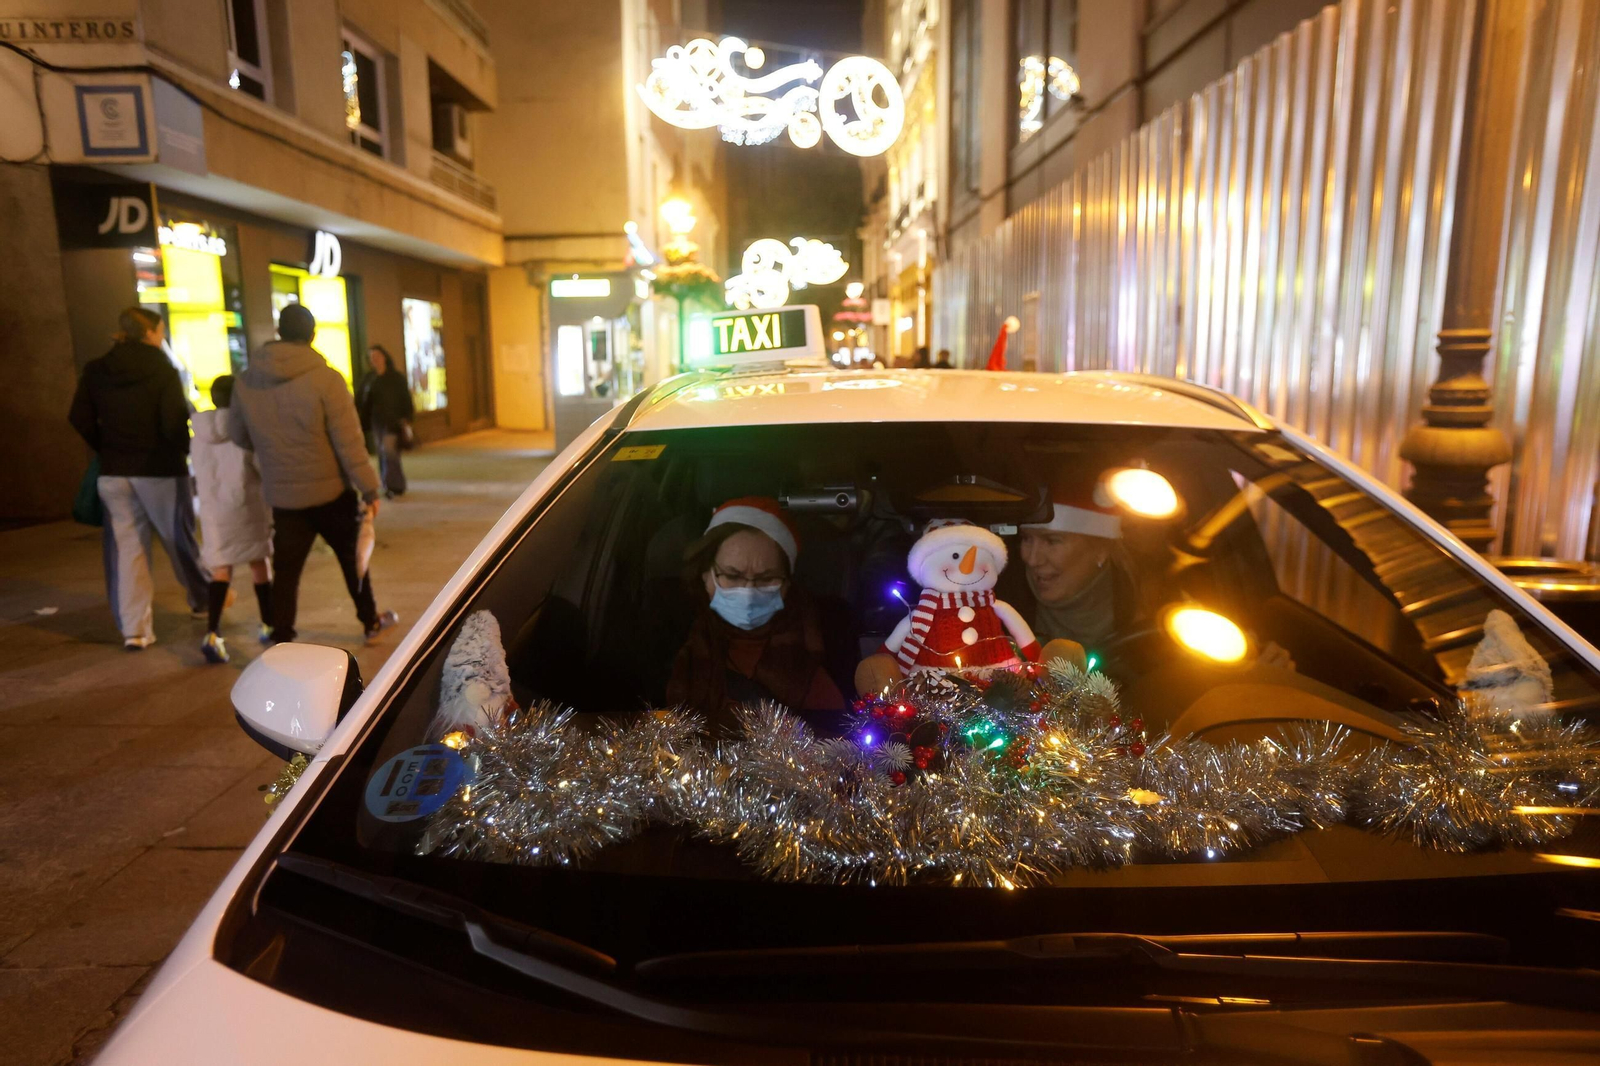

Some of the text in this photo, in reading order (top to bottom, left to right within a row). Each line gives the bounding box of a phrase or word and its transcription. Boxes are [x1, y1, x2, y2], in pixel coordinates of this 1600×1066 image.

[0, 22, 134, 39] UINTEROS
[98, 196, 148, 234] JD
[310, 231, 342, 277] JD
[714, 314, 781, 352] TAXI
[397, 762, 418, 796] ECO
